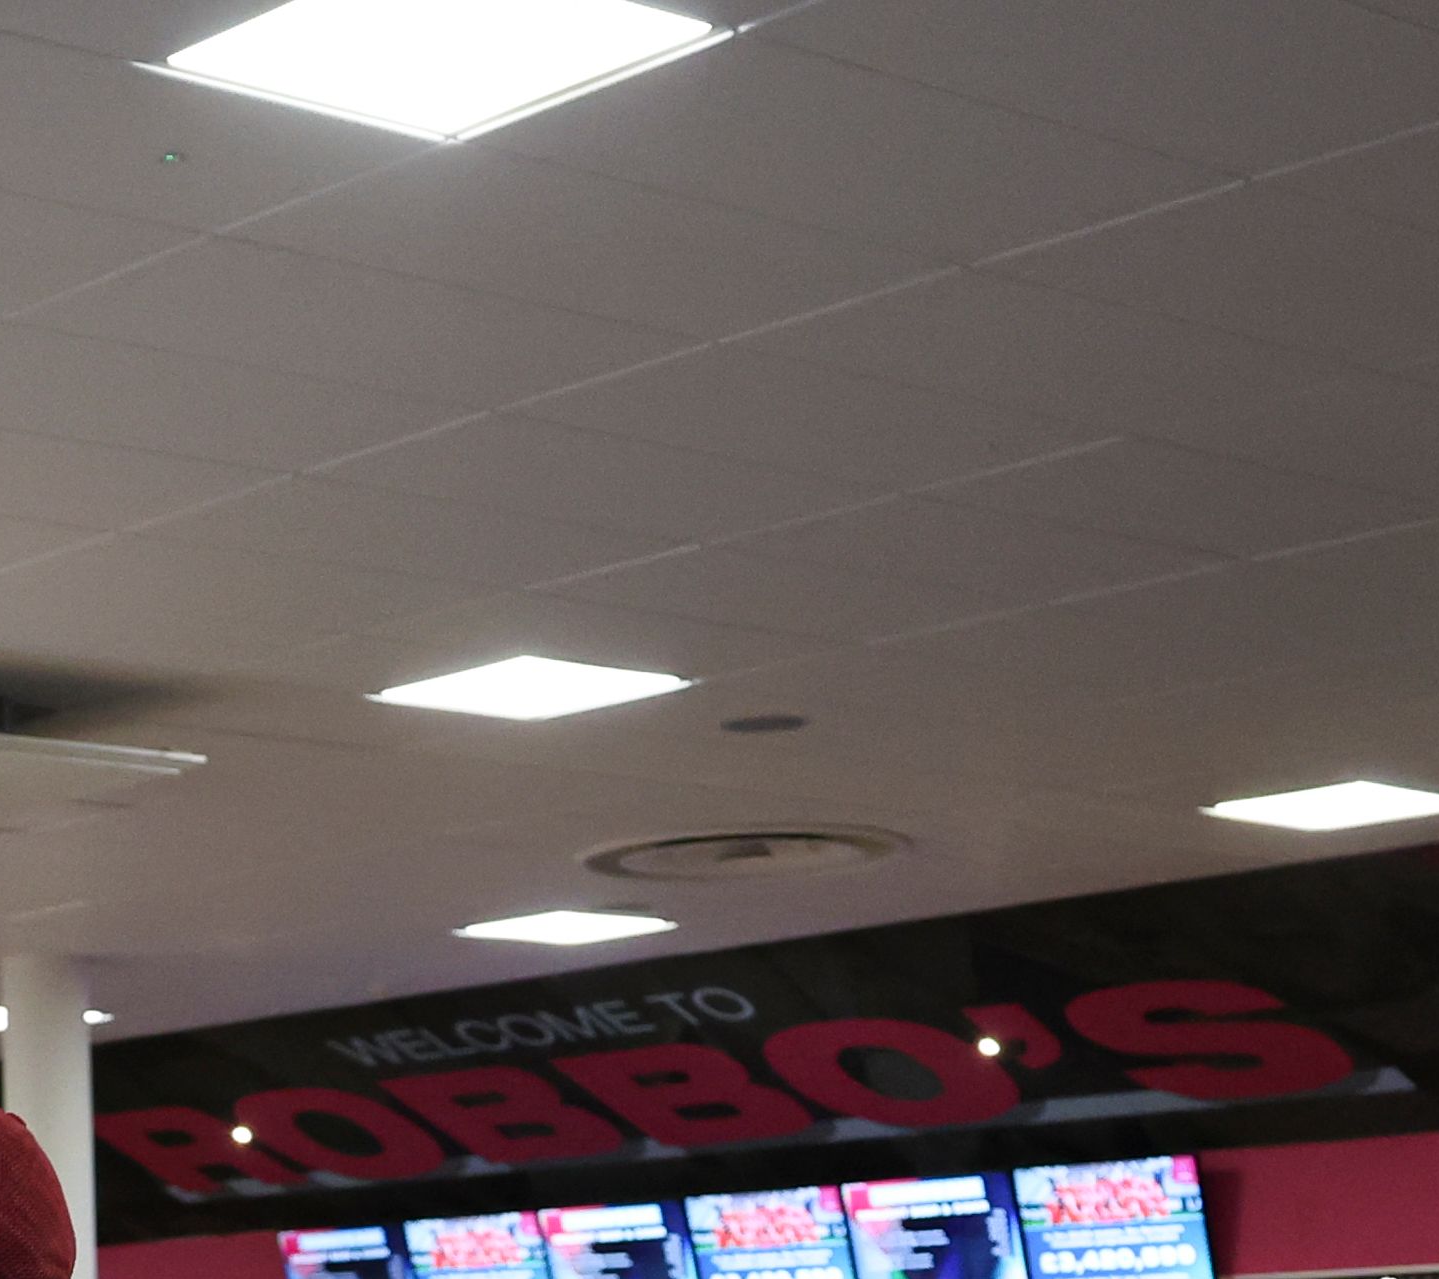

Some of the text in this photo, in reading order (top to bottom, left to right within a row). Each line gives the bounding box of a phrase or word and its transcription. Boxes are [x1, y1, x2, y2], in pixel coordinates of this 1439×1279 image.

[96, 978, 1360, 1198] ROBBO'S
[327, 985, 756, 1069] WELCOME TO
